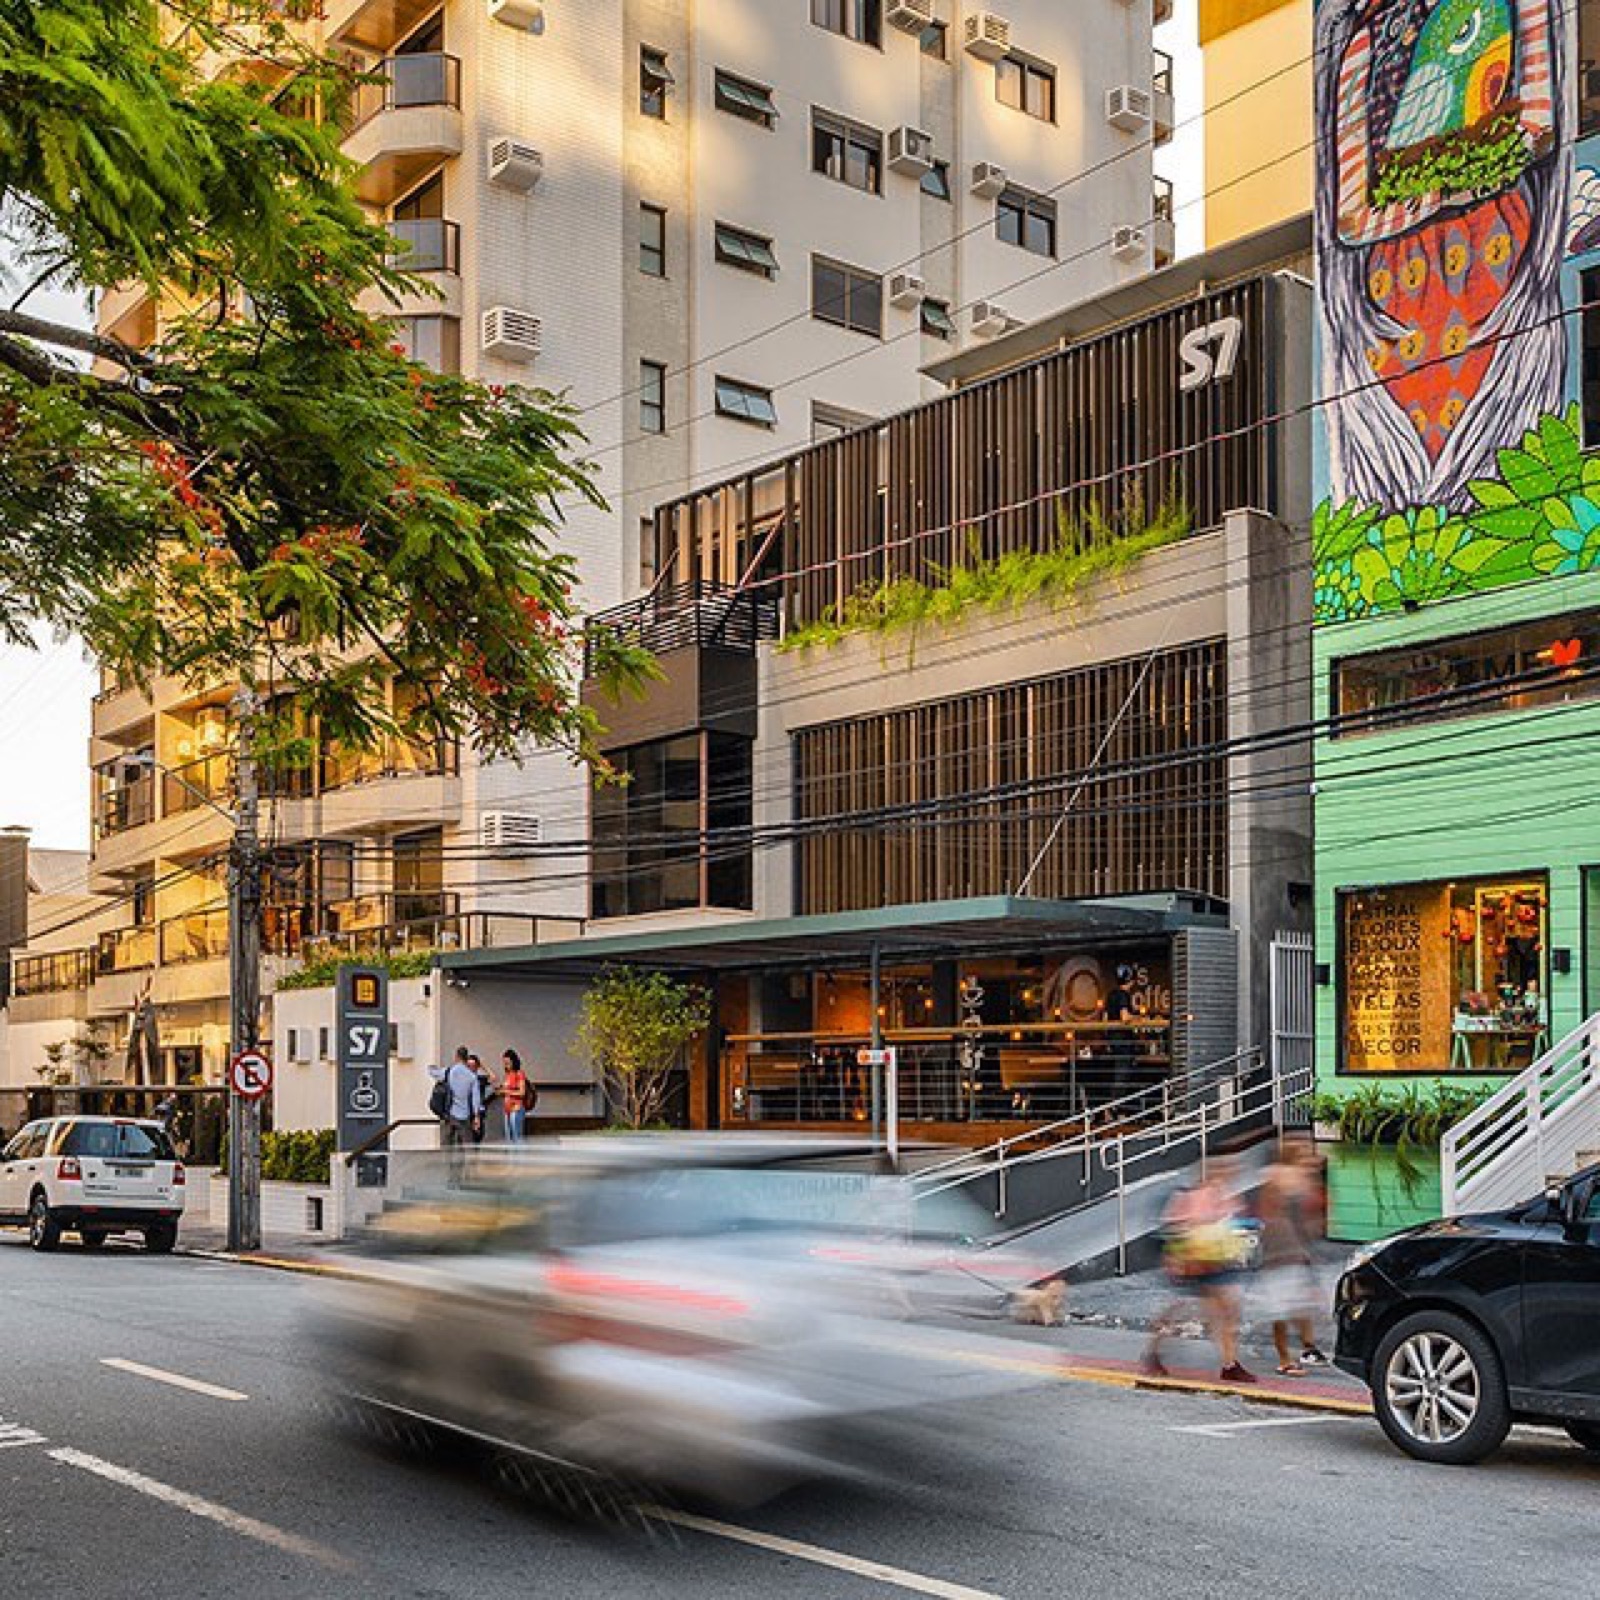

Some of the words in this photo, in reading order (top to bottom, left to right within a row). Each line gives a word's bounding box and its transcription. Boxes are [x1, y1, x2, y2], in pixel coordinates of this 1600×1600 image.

[1180, 316, 1242, 392] S7
[1349, 919, 1421, 937] FLORES
[1349, 934, 1421, 953] BIJOUX
[1349, 992, 1421, 1010] VELAS
[349, 1026, 380, 1056] S7
